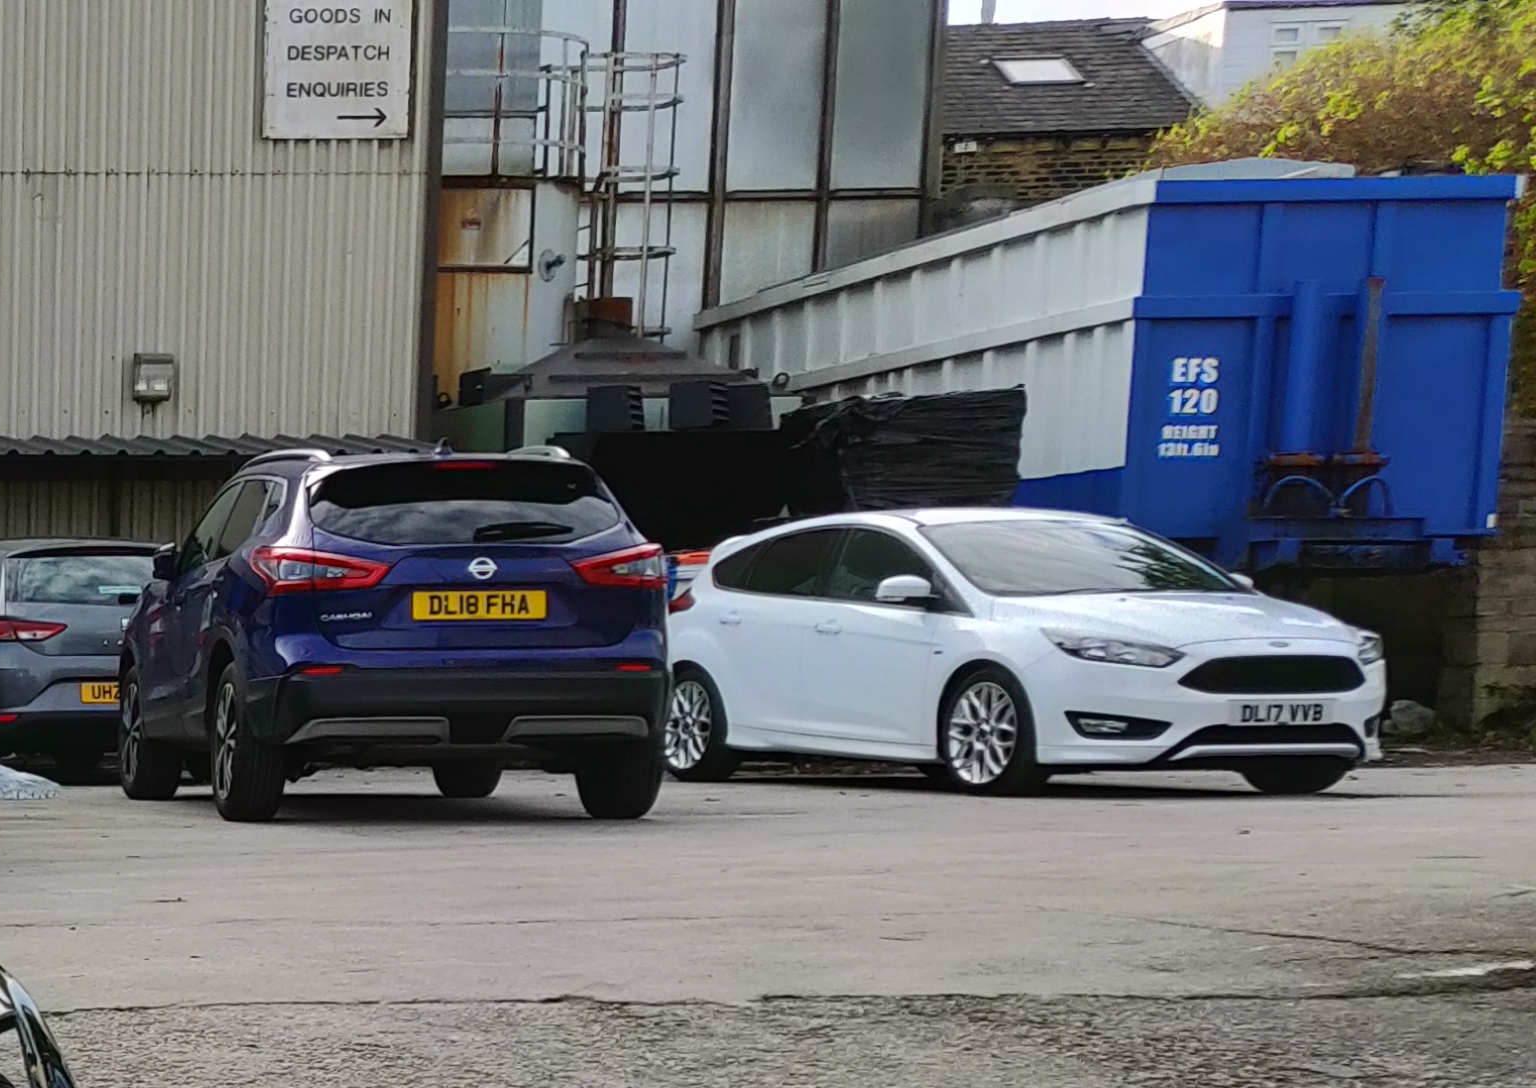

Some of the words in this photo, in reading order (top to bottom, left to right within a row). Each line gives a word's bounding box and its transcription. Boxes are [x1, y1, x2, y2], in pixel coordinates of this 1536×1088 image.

[289, 8, 361, 24] GOODS
[374, 8, 391, 24] IN
[287, 45, 390, 61] DESPATCH
[286, 81, 389, 98] ENQUIRIES
[1172, 358, 1219, 383] EFS
[1169, 388, 1218, 414] 120
[428, 594, 478, 615] DL18
[485, 594, 531, 615] FHA
[1240, 704, 1283, 723] DL17
[1288, 703, 1323, 722] VVB
